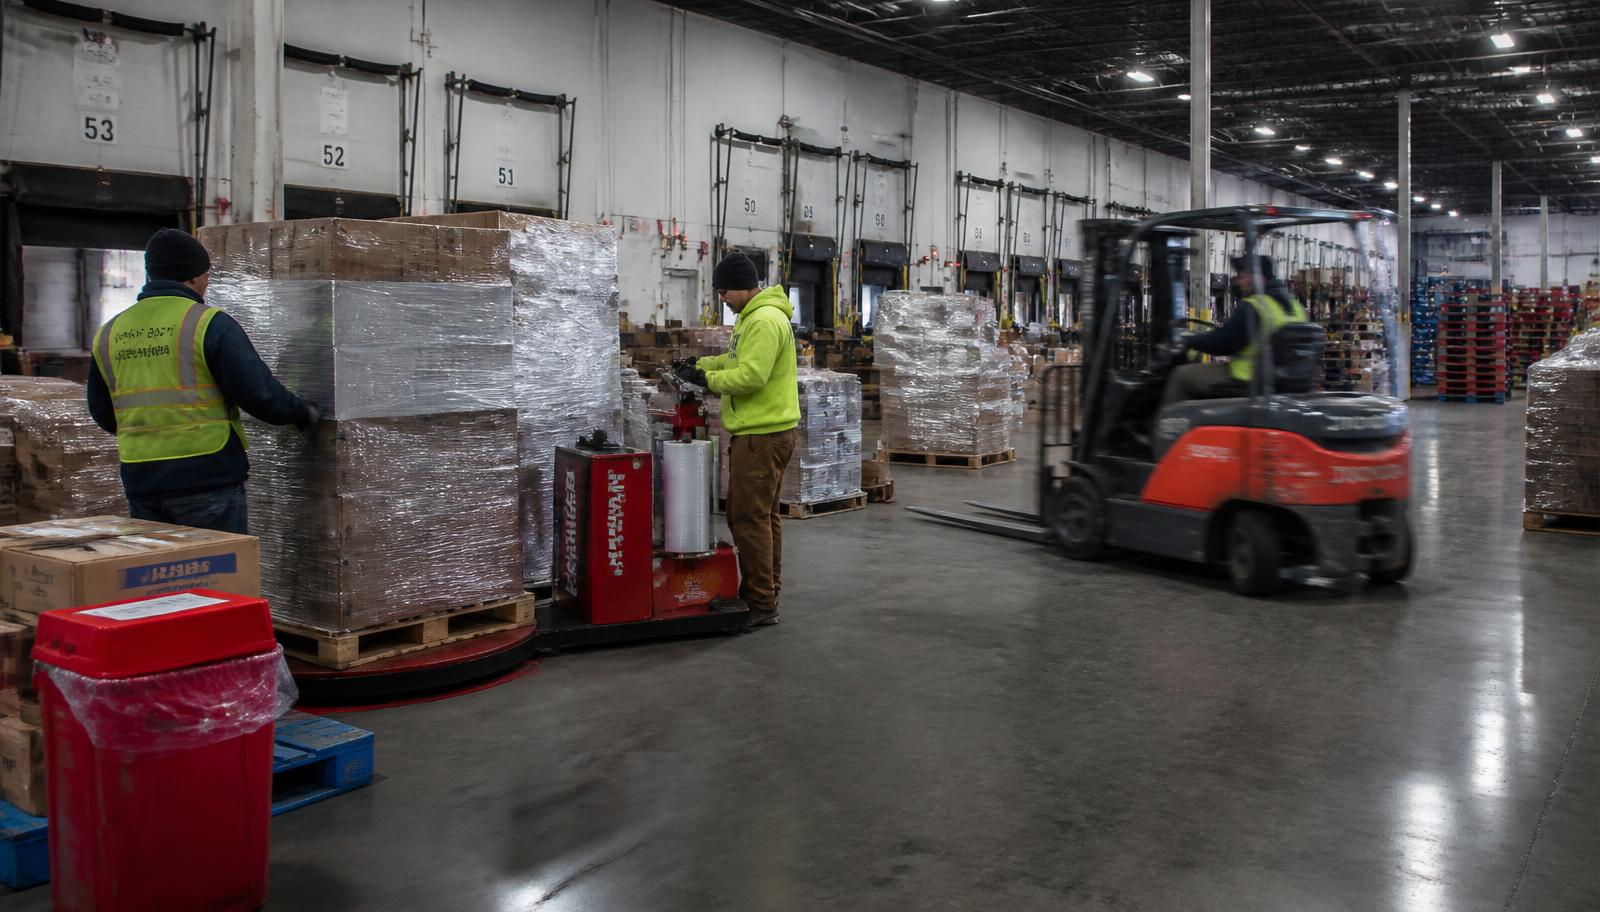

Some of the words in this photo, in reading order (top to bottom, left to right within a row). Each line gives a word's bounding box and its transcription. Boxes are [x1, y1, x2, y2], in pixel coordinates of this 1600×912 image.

[85, 116, 114, 141] 53
[323, 144, 345, 167] 52
[499, 167, 513, 186] 51
[744, 197, 756, 213] 50
